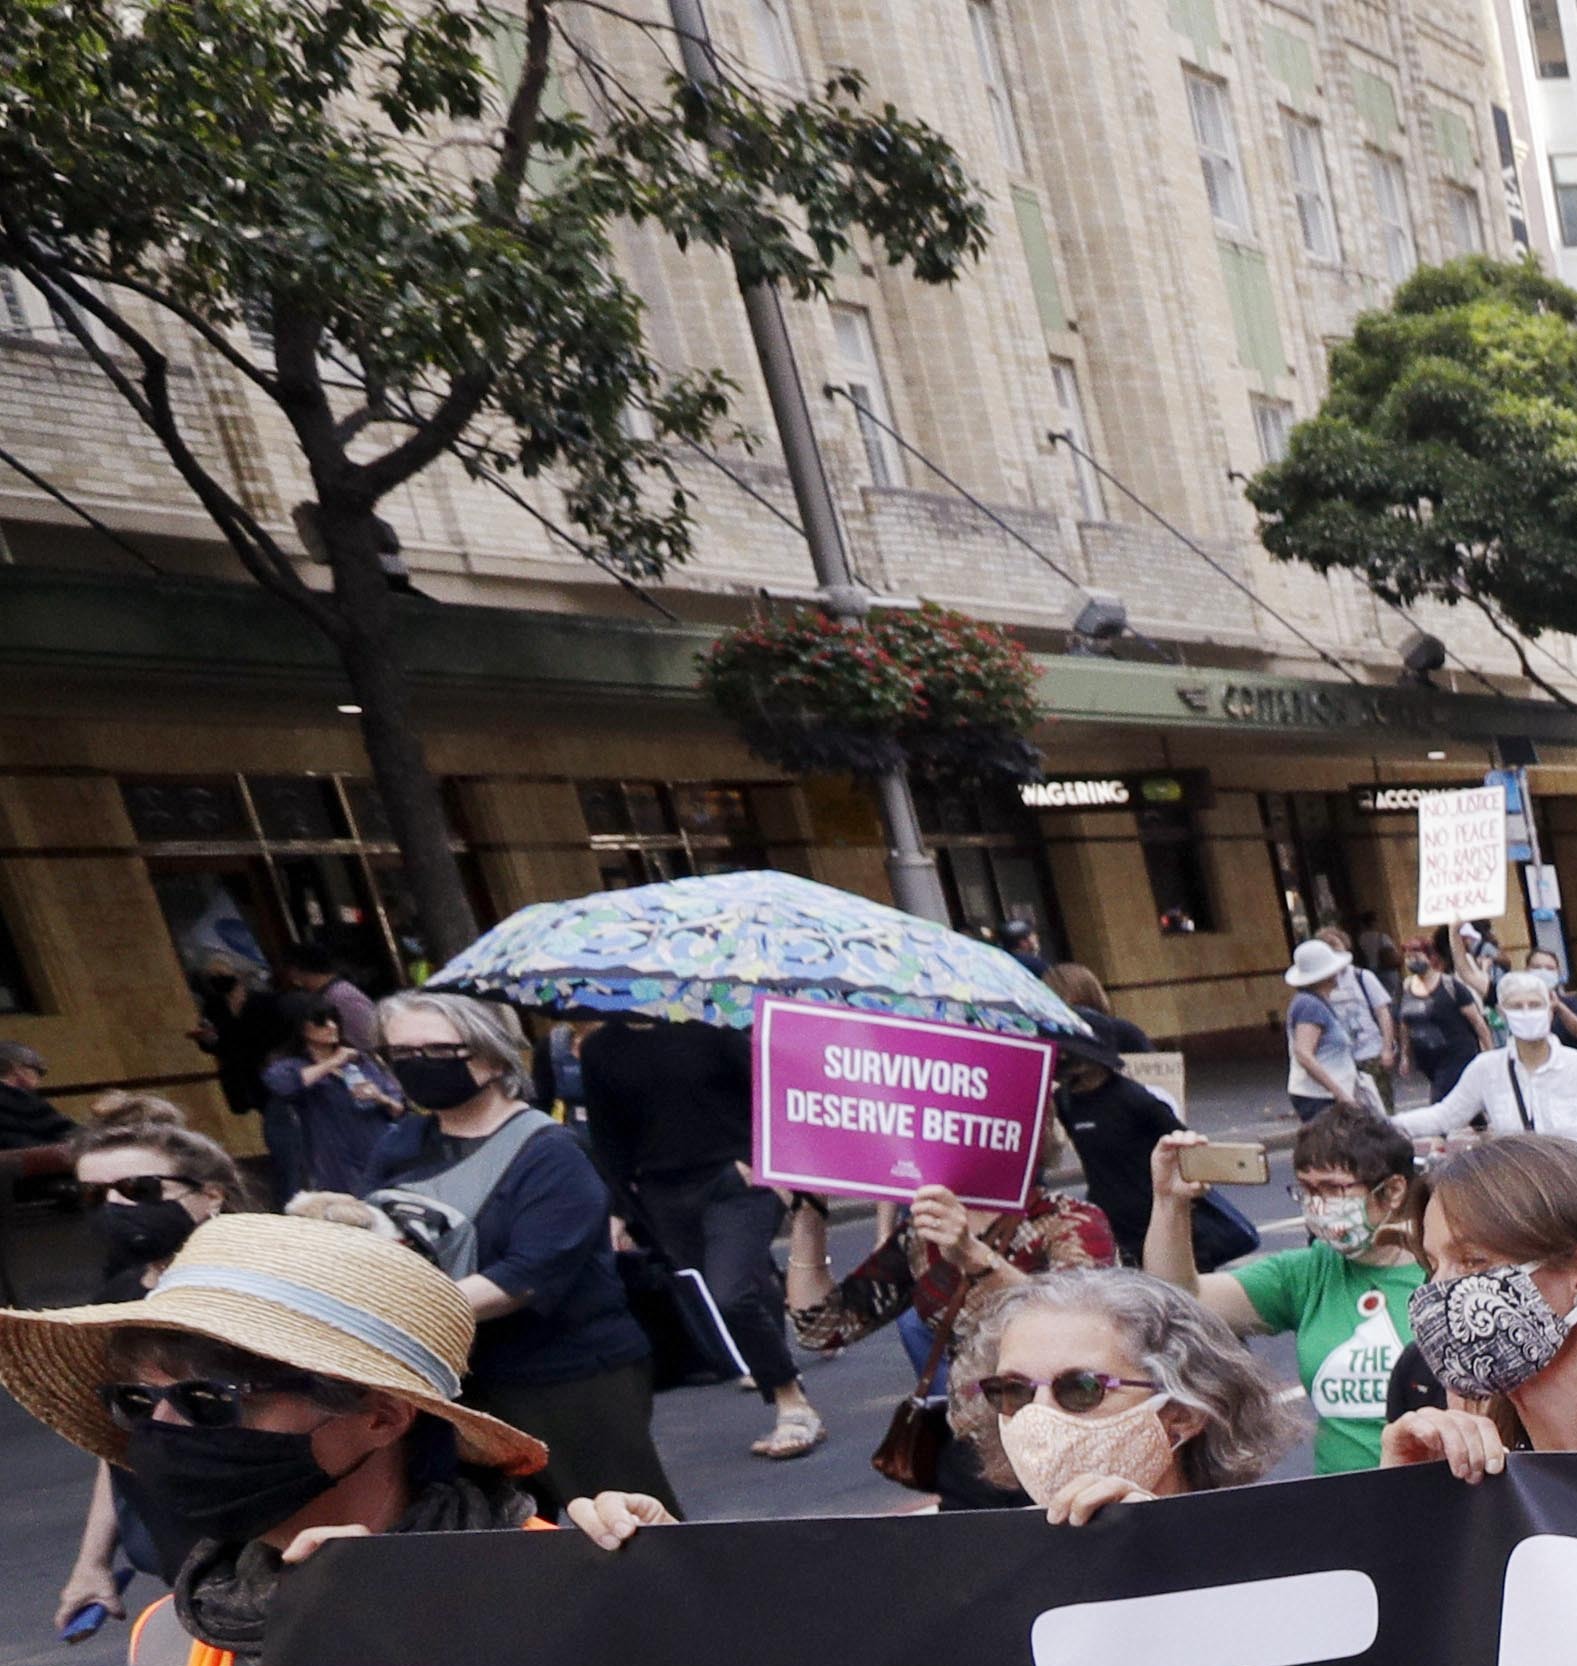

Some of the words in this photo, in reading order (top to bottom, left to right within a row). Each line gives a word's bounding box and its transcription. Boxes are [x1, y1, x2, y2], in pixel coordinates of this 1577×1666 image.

[1424, 798, 1448, 817] NO
[1451, 791, 1500, 816] JUSTICE
[1424, 827, 1448, 848] NO
[1456, 819, 1498, 844] PEACE
[1426, 851, 1448, 872] NO
[1455, 845, 1499, 867] RAPIST
[1426, 863, 1496, 889] ATTORNEY
[1424, 888, 1494, 914] GENERAL
[824, 1045, 989, 1101] SURVIVORS
[786, 1088, 916, 1138] DESERVE
[922, 1107, 1022, 1153] BETTER
[1349, 1344, 1393, 1373] THE
